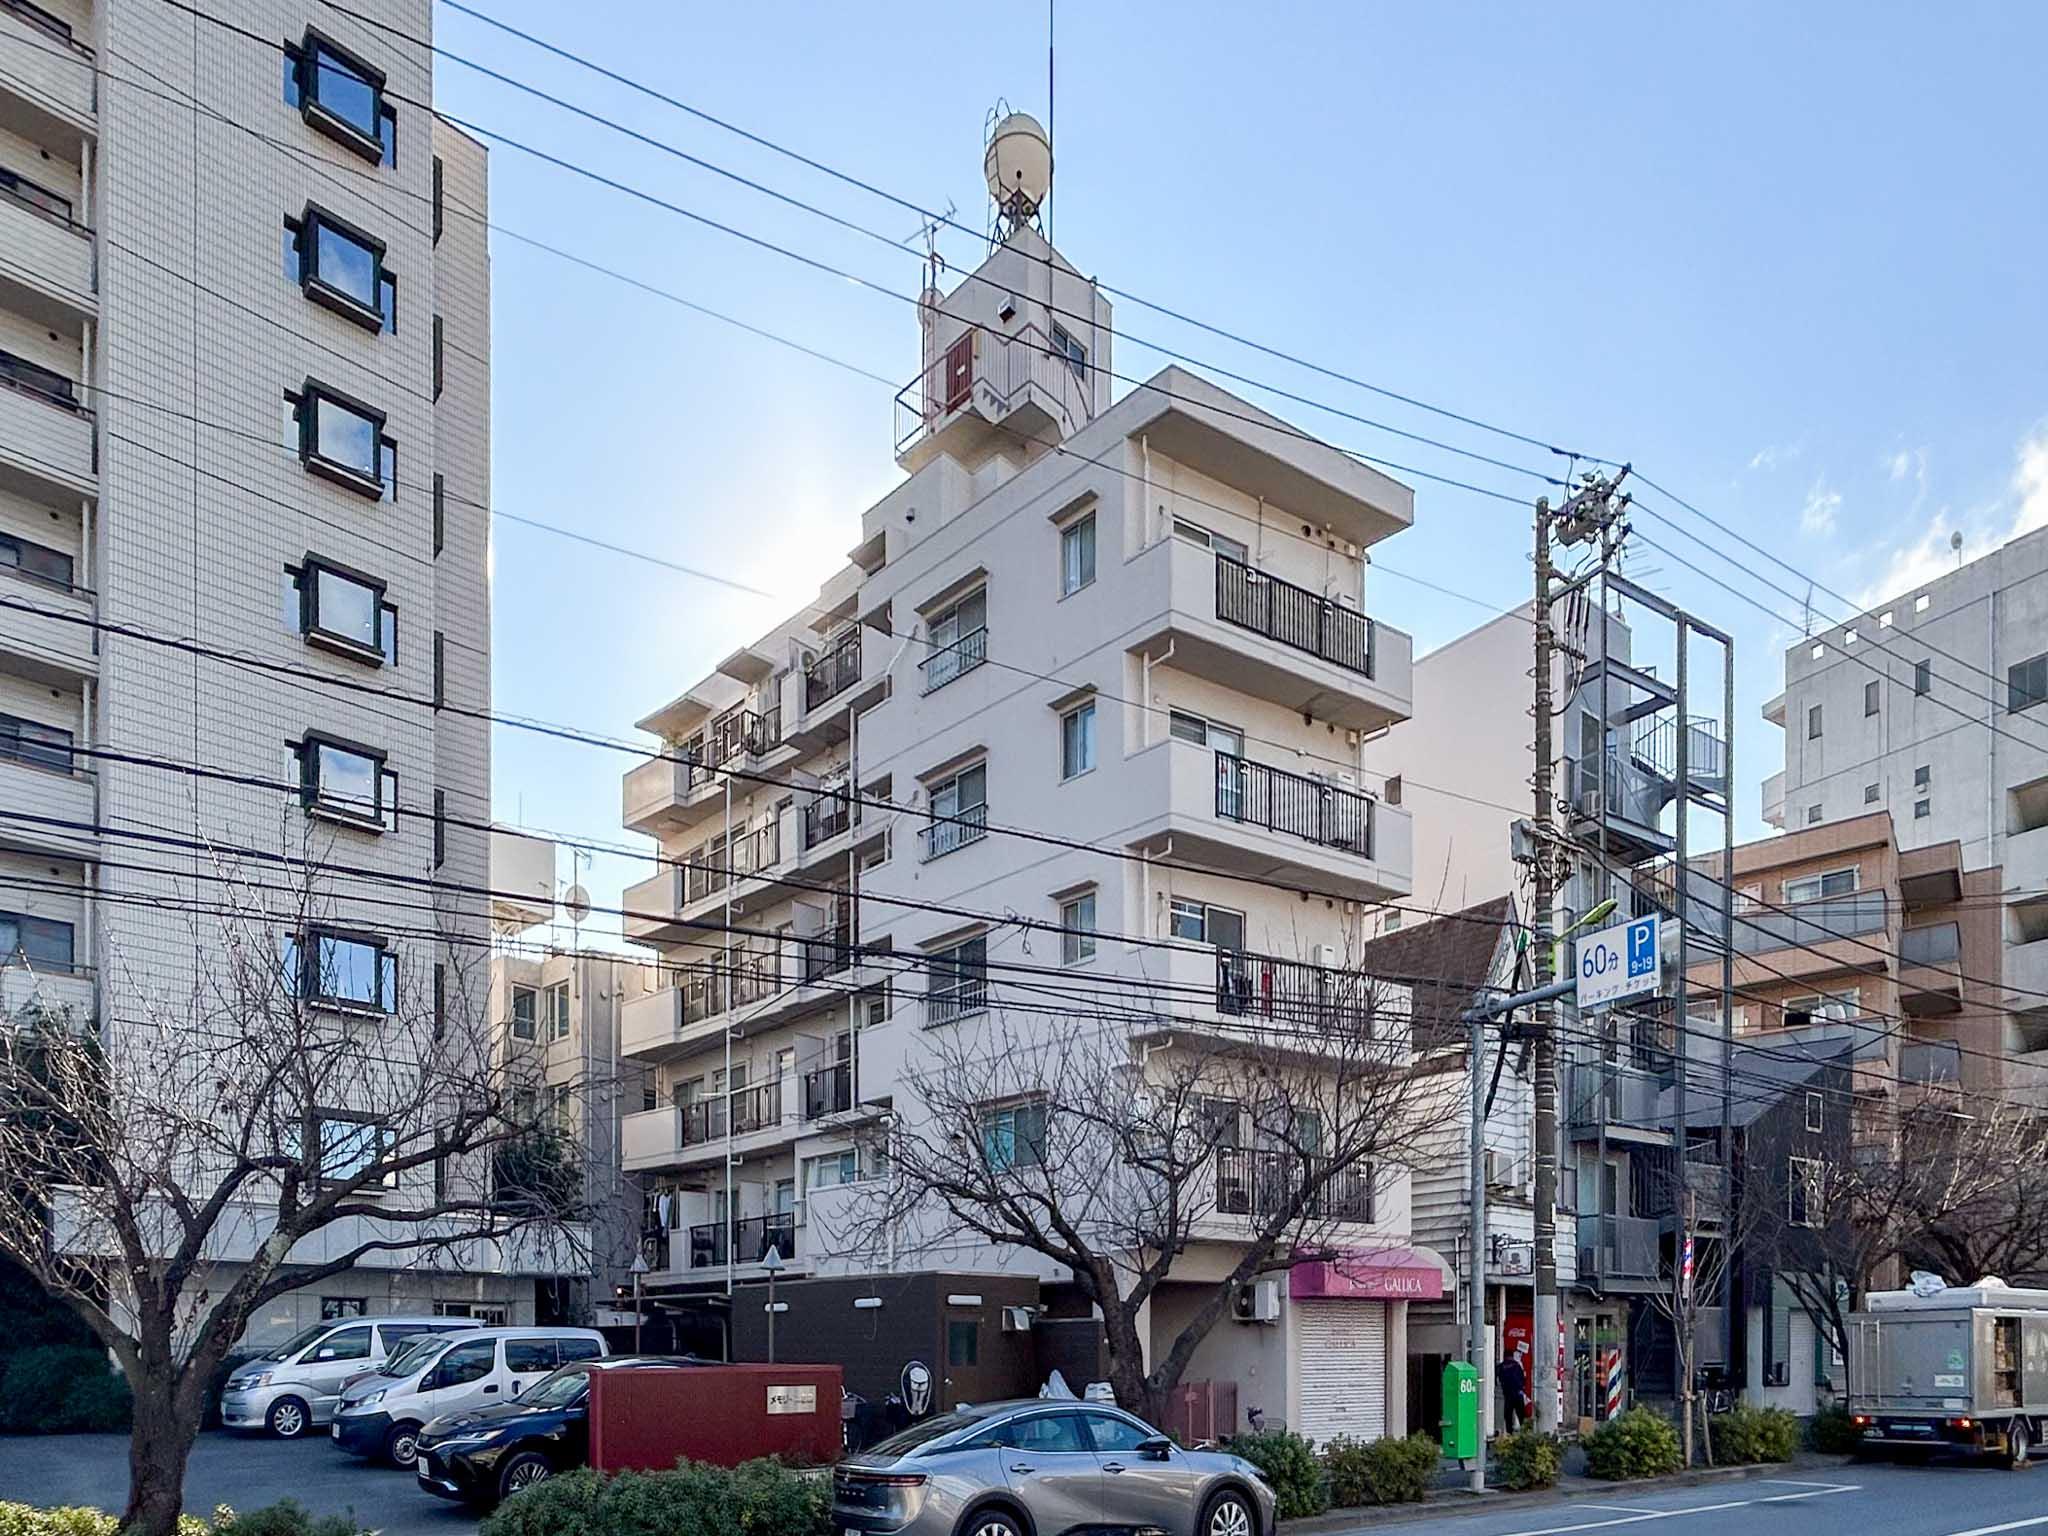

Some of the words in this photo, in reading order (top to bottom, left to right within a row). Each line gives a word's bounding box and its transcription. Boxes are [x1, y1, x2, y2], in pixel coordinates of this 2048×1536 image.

[1635, 926, 1650, 957] P
[1583, 944, 1618, 978] 60分
[1632, 956, 1653, 973] 9-19
